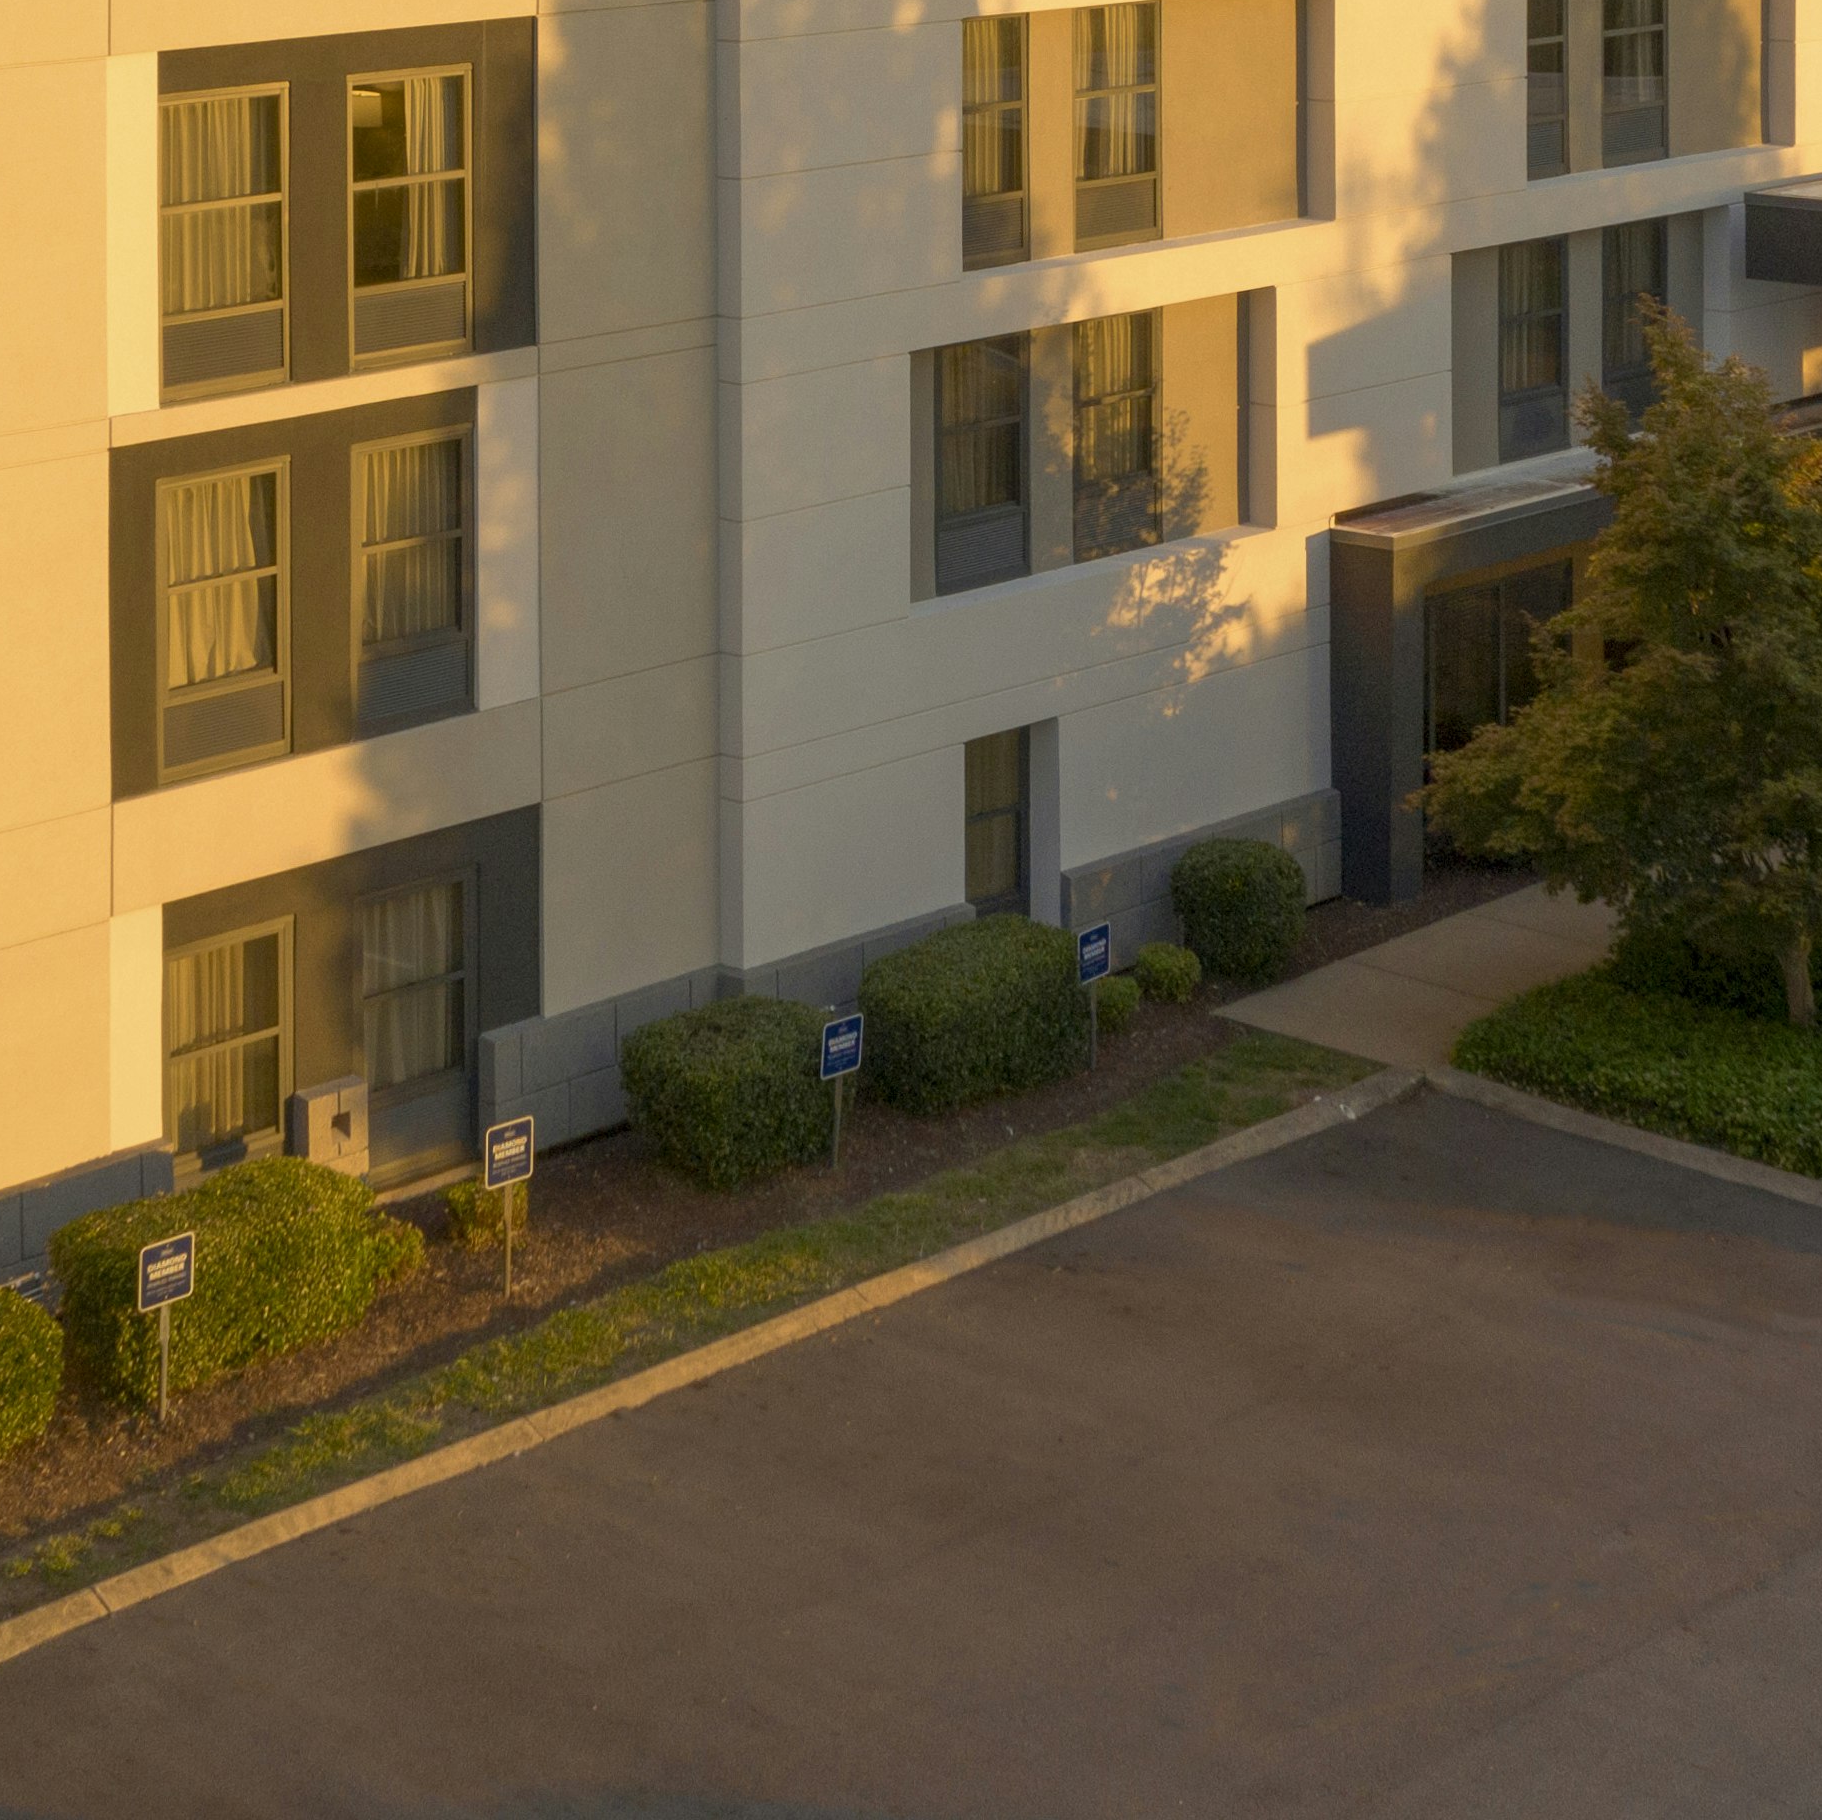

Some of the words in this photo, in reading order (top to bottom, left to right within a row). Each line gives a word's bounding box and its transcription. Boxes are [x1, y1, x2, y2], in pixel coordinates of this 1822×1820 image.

[492, 1135, 528, 1154] DIAMOND
[494, 1145, 526, 1161] MEMBER
[147, 1252, 188, 1274] DIAMOND
[149, 1262, 186, 1281] MEMBER
